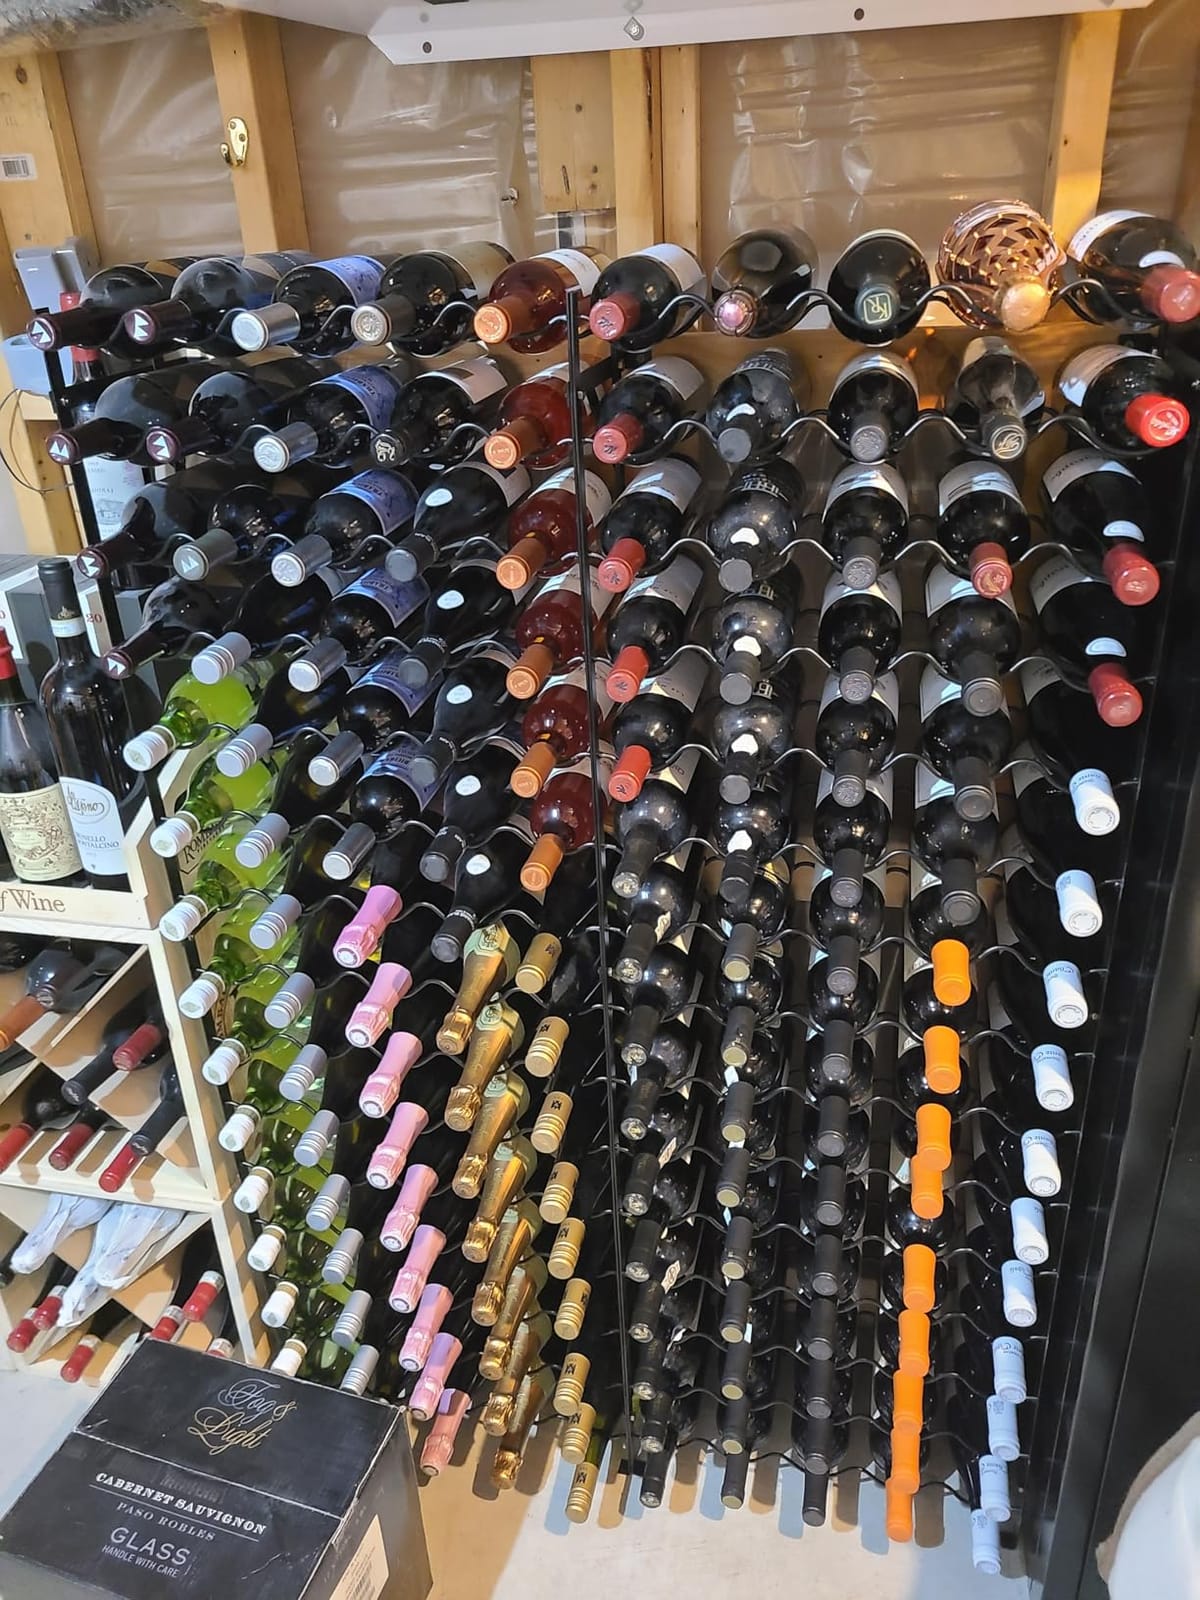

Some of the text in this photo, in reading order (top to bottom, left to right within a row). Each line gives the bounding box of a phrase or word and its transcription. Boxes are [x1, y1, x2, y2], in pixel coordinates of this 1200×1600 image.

[7, 888, 66, 912] Wine
[217, 1378, 281, 1425] Fog
[187, 1406, 273, 1456] Light
[95, 1472, 267, 1535] CABERNET SAUVIGNON
[116, 1501, 216, 1541] PASO ROBLES
[101, 1544, 180, 1578] HANDLE WITH CARE
[110, 1526, 191, 1566] GLASS
